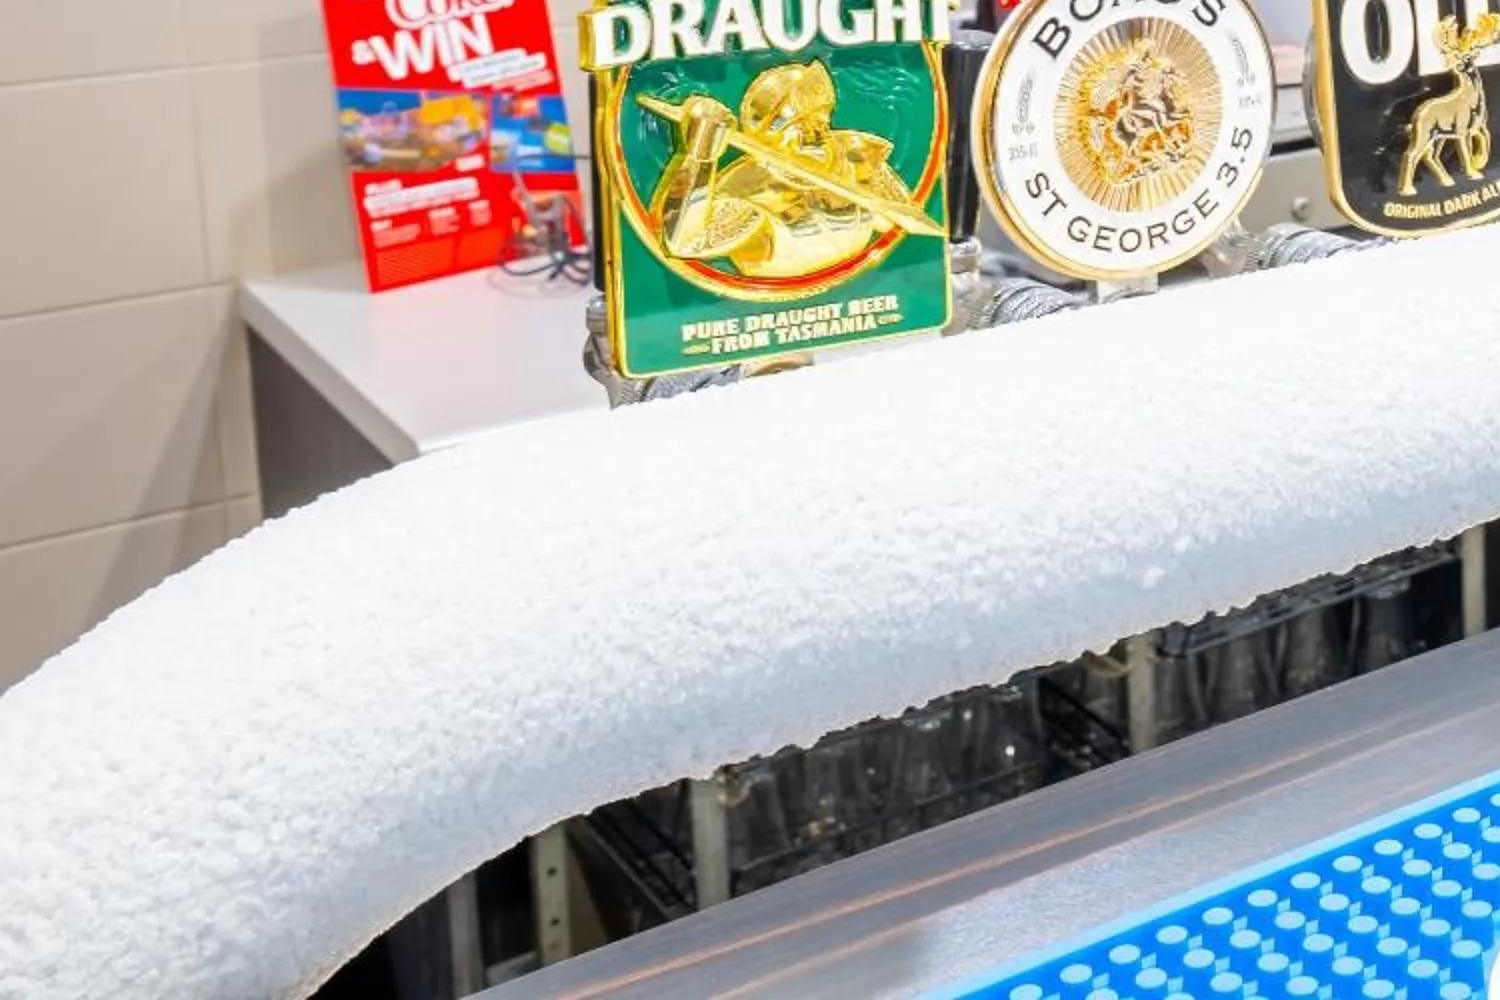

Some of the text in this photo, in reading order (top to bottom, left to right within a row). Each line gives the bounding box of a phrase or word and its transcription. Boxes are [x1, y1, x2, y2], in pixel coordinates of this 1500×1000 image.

[368, 13, 495, 81] WIN
[1024, 126, 1254, 254] ST GEORGE 3.5
[1383, 201, 1443, 219] ORIGINAL
[1443, 190, 1482, 215] DARK
[681, 295, 900, 343] PURE DRAUGHT BEER
[711, 313, 878, 355] FROM TASMANIA
